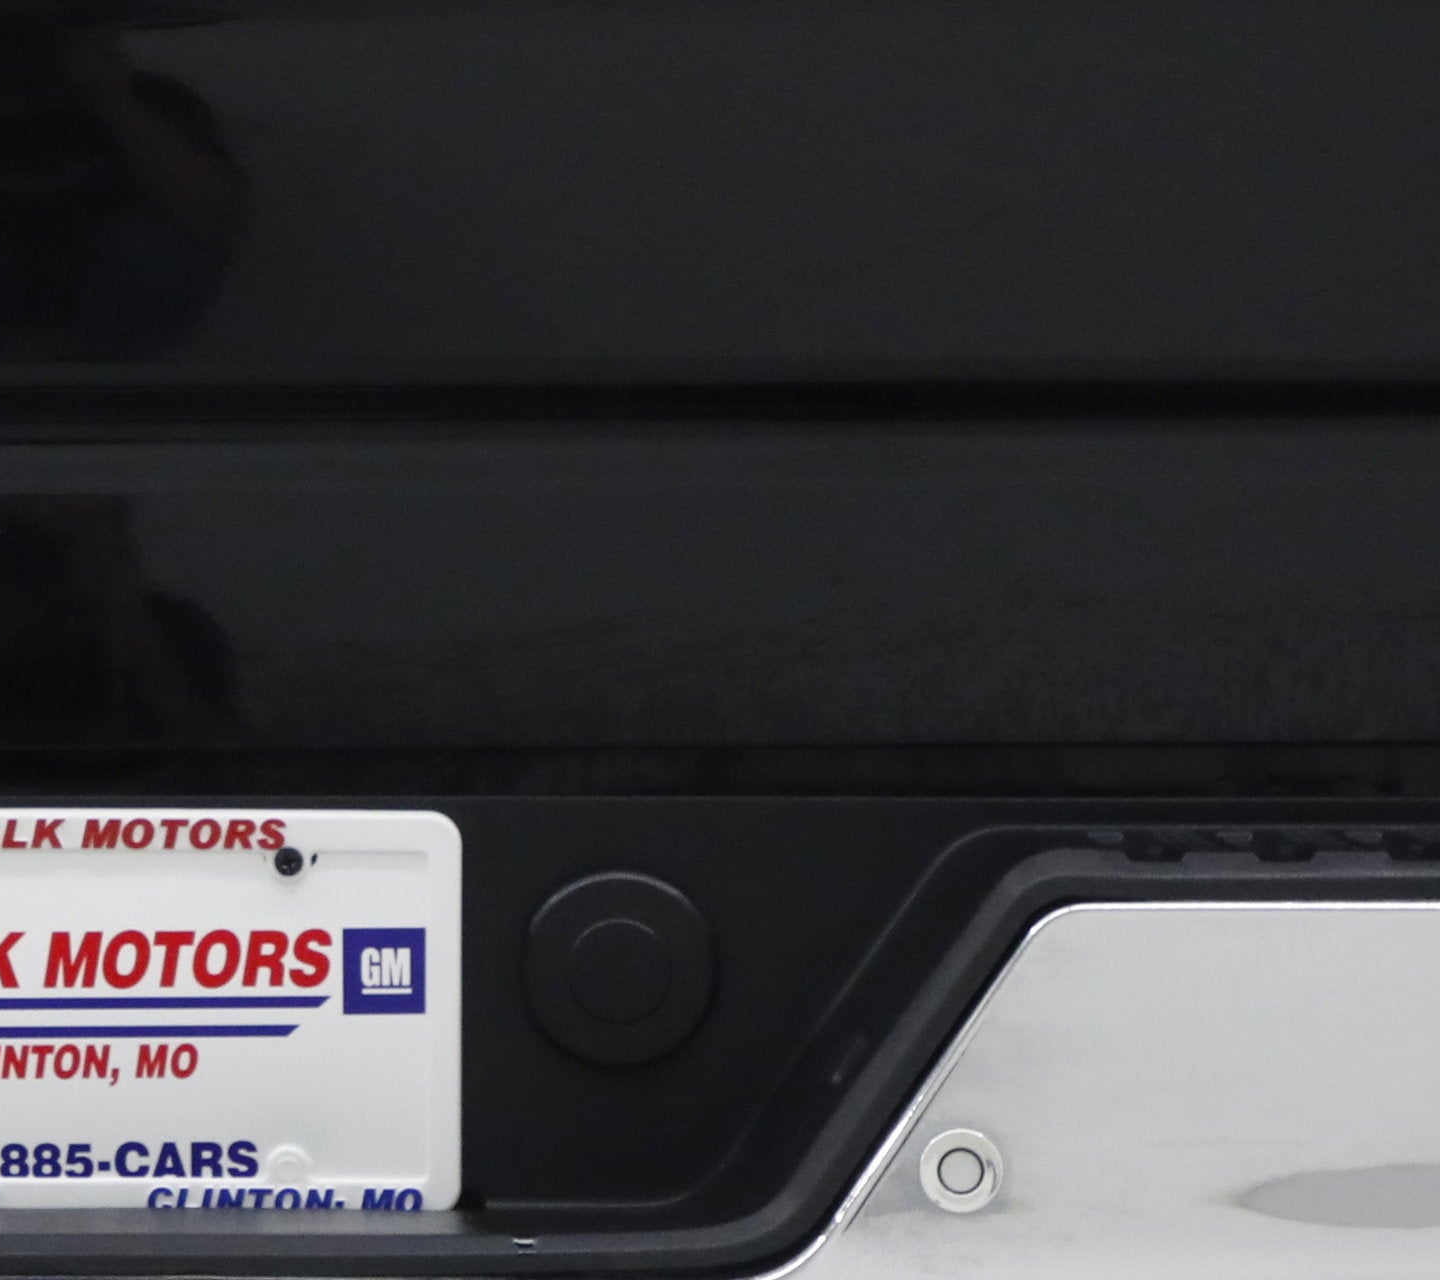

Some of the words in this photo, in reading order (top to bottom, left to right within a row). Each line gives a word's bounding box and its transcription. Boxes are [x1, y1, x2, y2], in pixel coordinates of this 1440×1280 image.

[80, 818, 288, 851] MOTORS
[42, 928, 333, 990] MOTORS
[360, 946, 412, 988] GM
[135, 1043, 200, 1080] MO
[361, 1187, 423, 1211] MO
